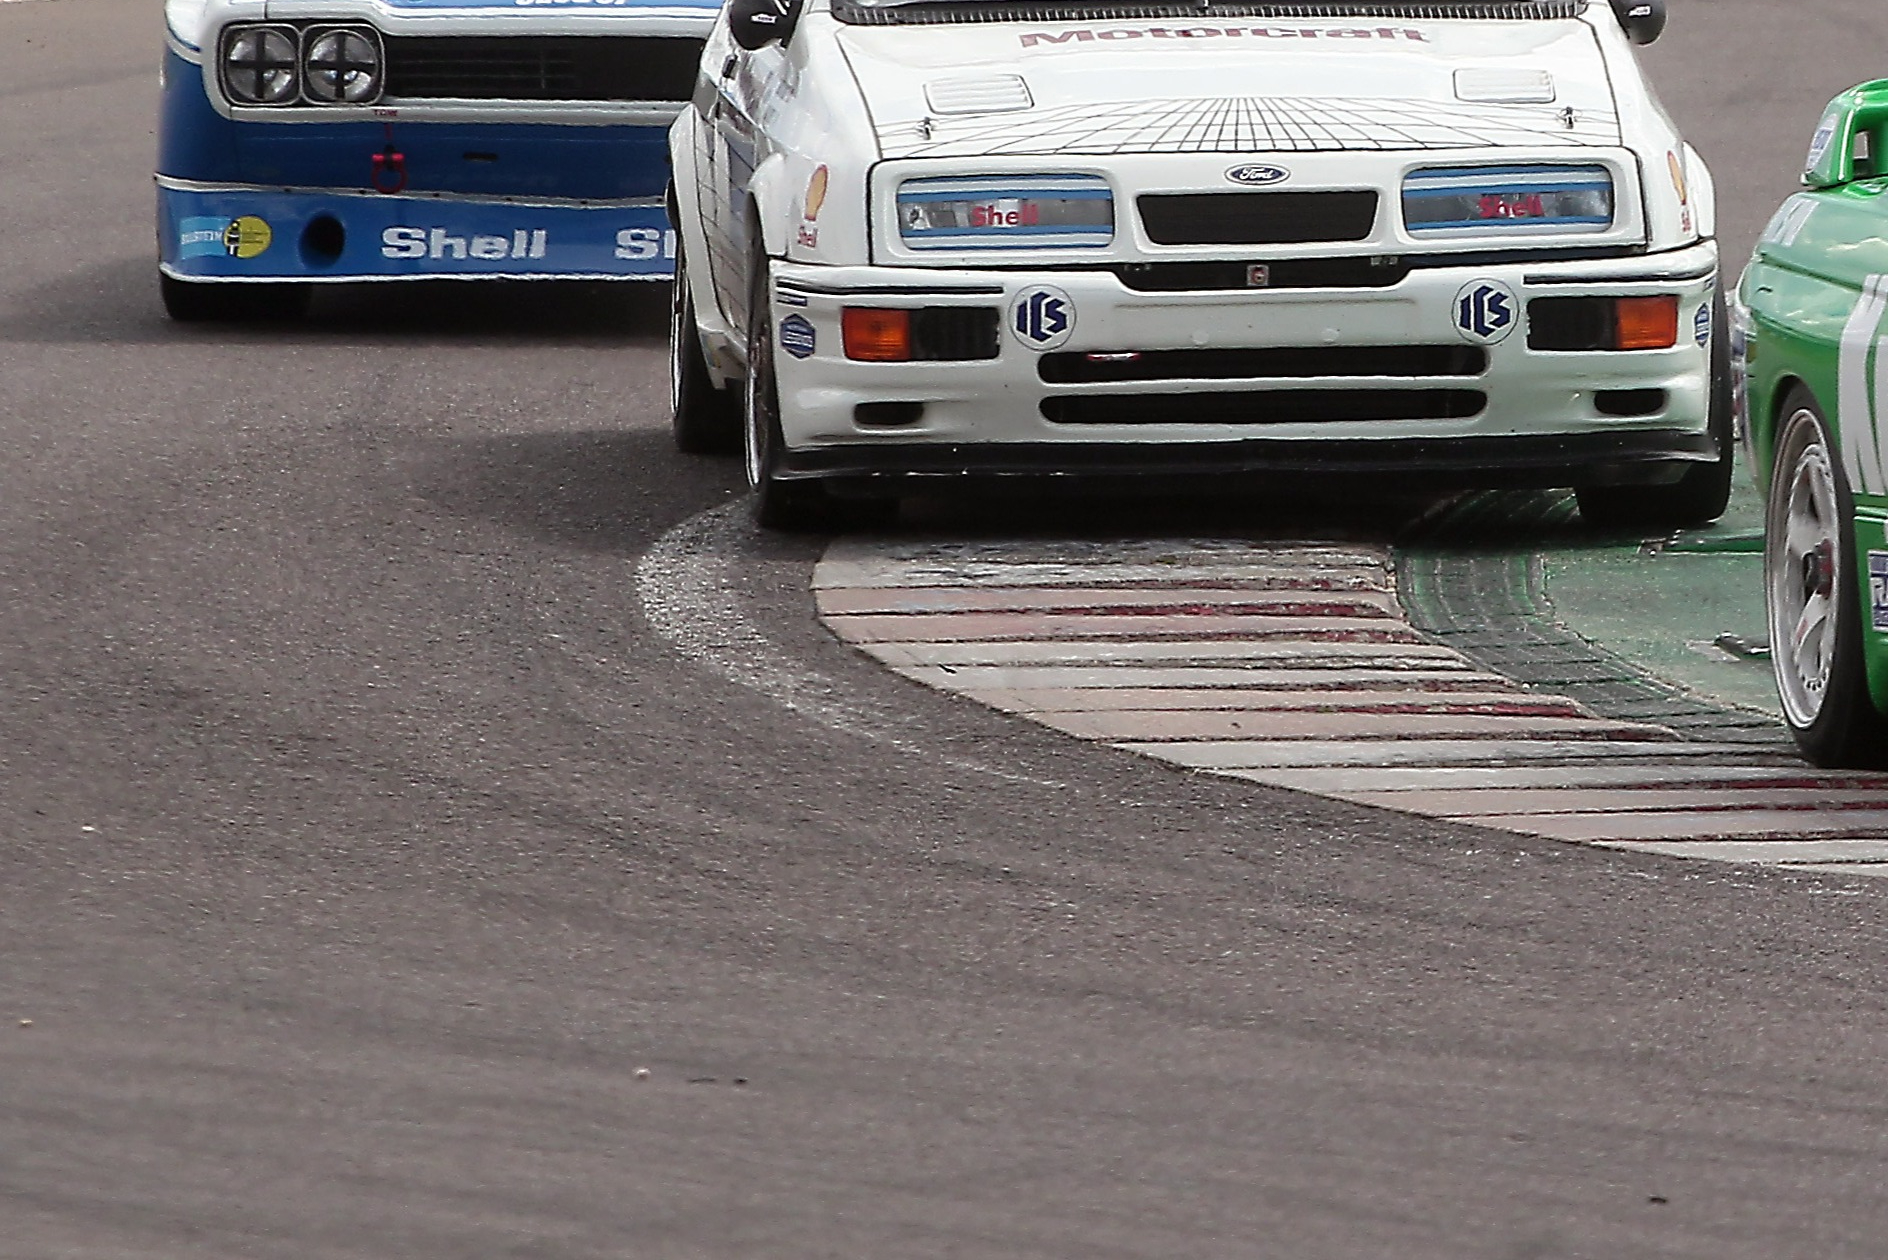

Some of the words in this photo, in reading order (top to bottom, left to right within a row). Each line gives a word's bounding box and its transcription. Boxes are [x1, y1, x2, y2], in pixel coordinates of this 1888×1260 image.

[1018, 26, 1431, 48] Motorcraft
[1239, 166, 1275, 180] Ford
[971, 203, 1039, 227] Shell
[1479, 194, 1544, 218] Shell
[381, 226, 548, 259] Shell
